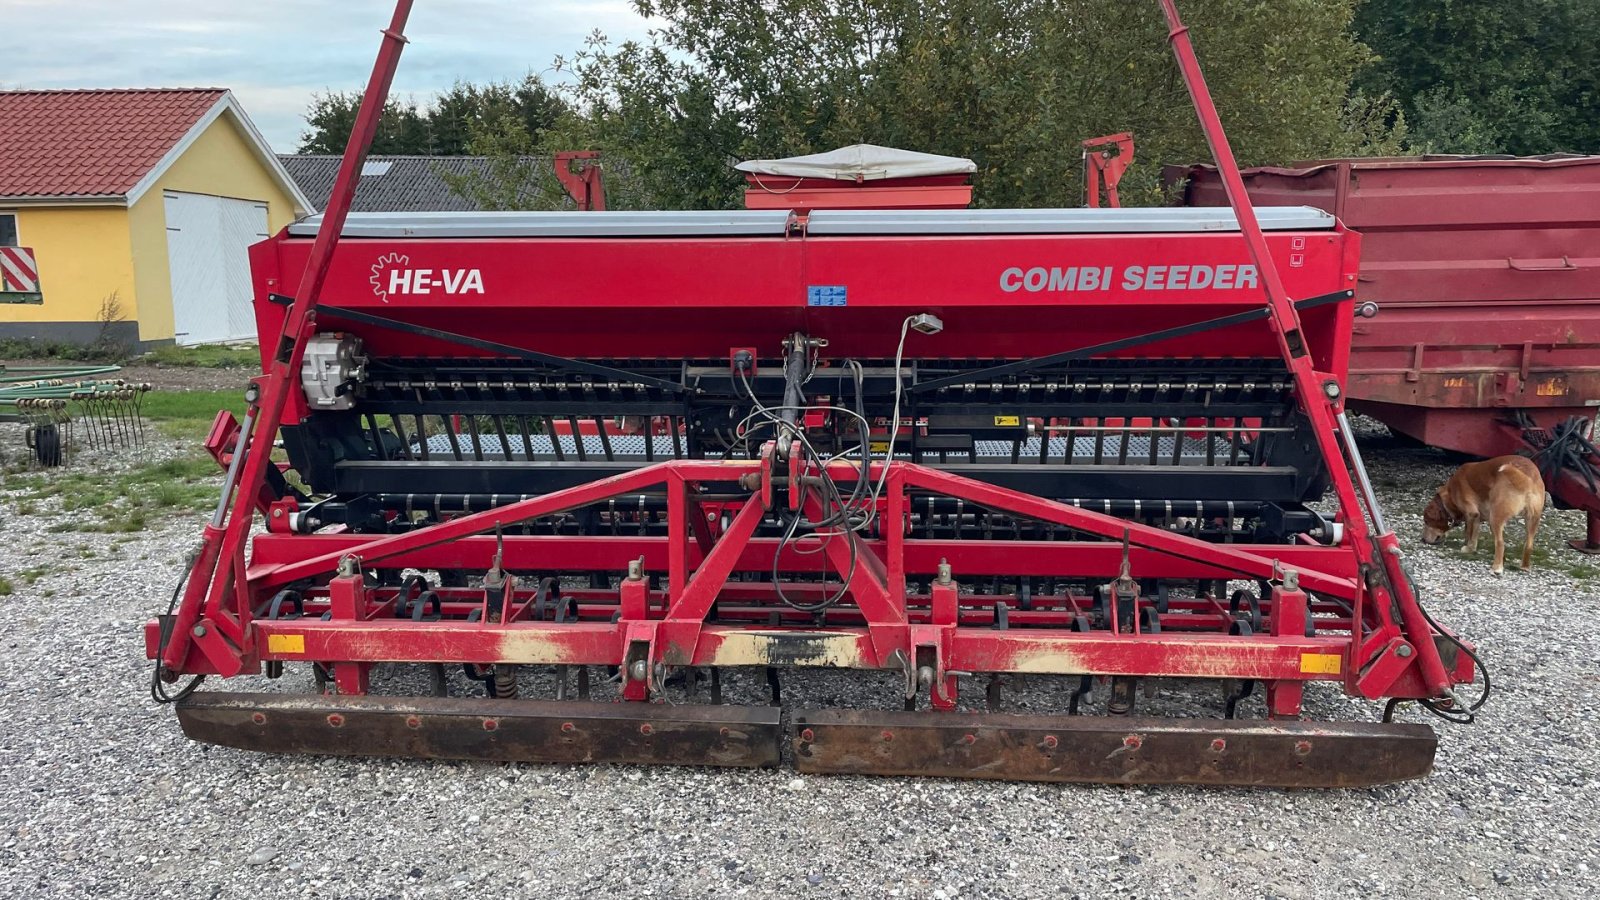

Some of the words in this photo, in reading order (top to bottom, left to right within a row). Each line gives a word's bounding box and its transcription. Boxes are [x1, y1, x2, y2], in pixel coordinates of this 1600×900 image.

[388, 269, 485, 294] HE-VA
[1000, 266, 1112, 292] COMBI
[1121, 265, 1258, 291] SEEDER
